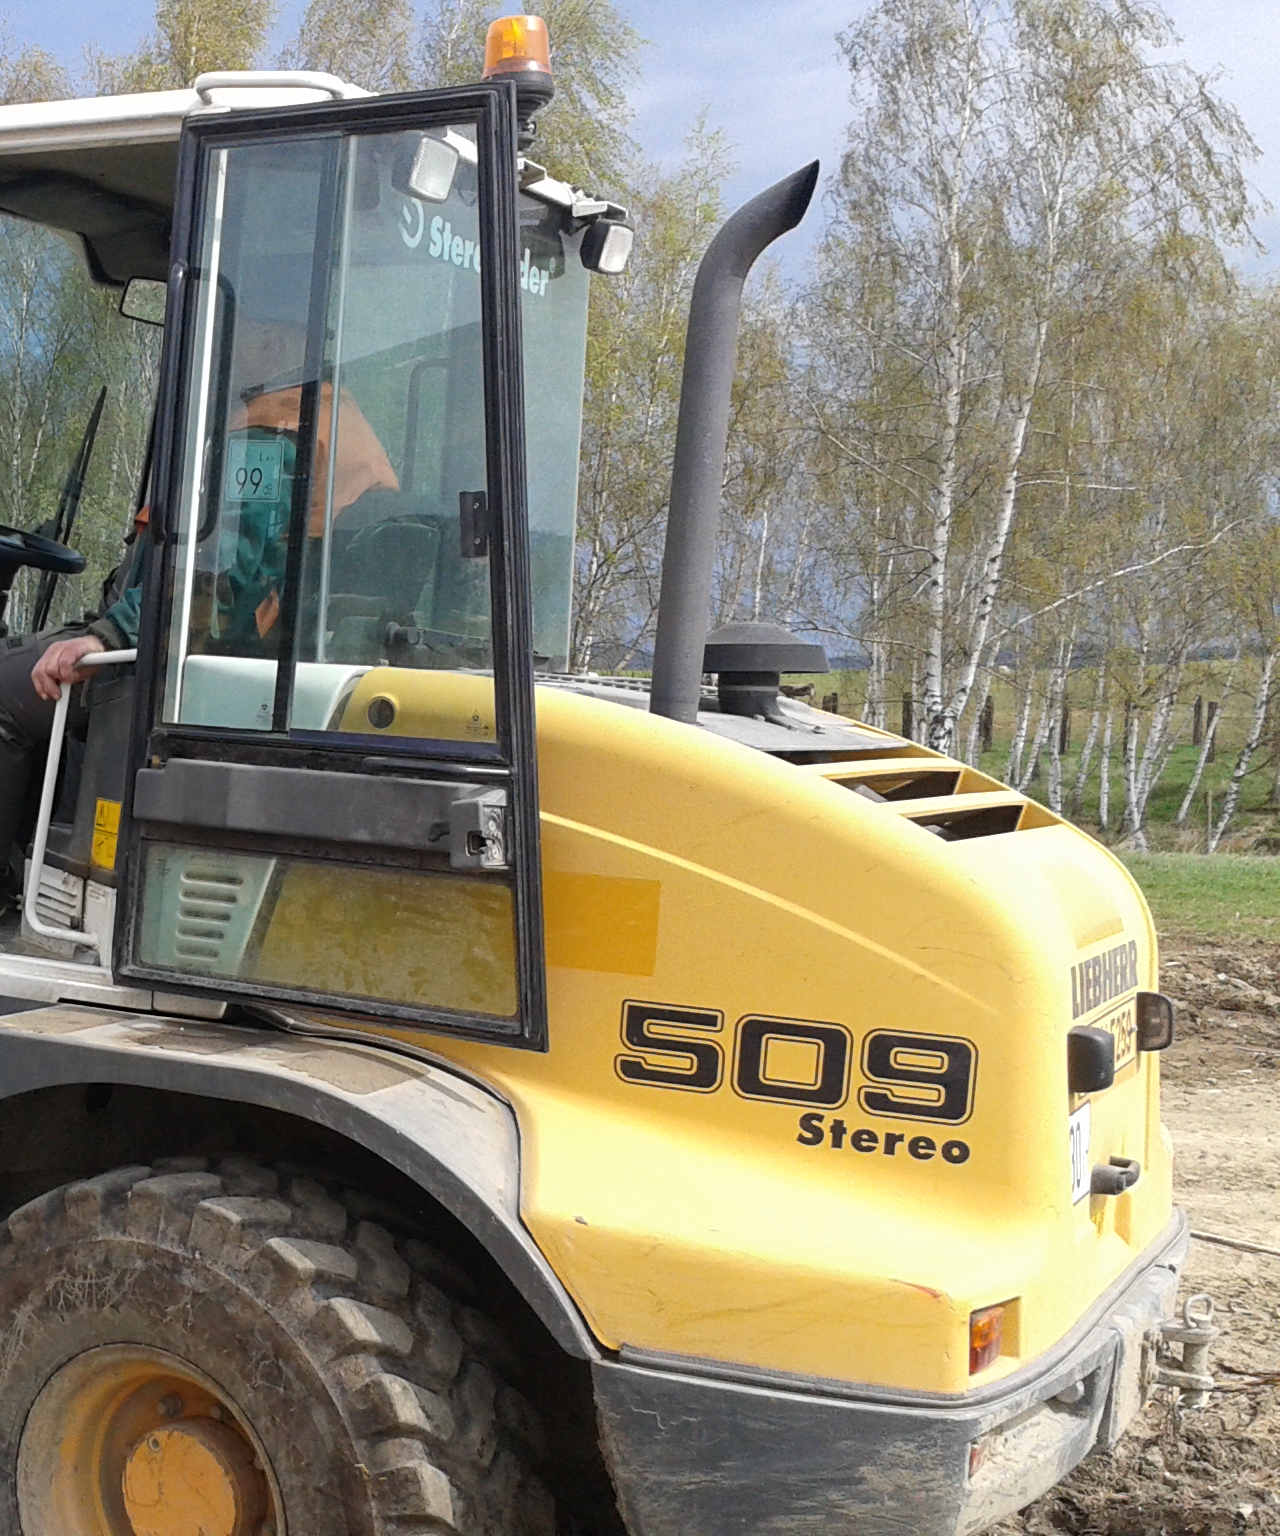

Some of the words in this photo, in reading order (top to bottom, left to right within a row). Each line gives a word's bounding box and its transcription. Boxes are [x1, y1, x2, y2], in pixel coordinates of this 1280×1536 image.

[235, 467, 263, 495] 99
[1070, 939, 1139, 1020] LIEBHERR
[614, 998, 979, 1126] 509
[796, 1112, 971, 1165] Stereo
